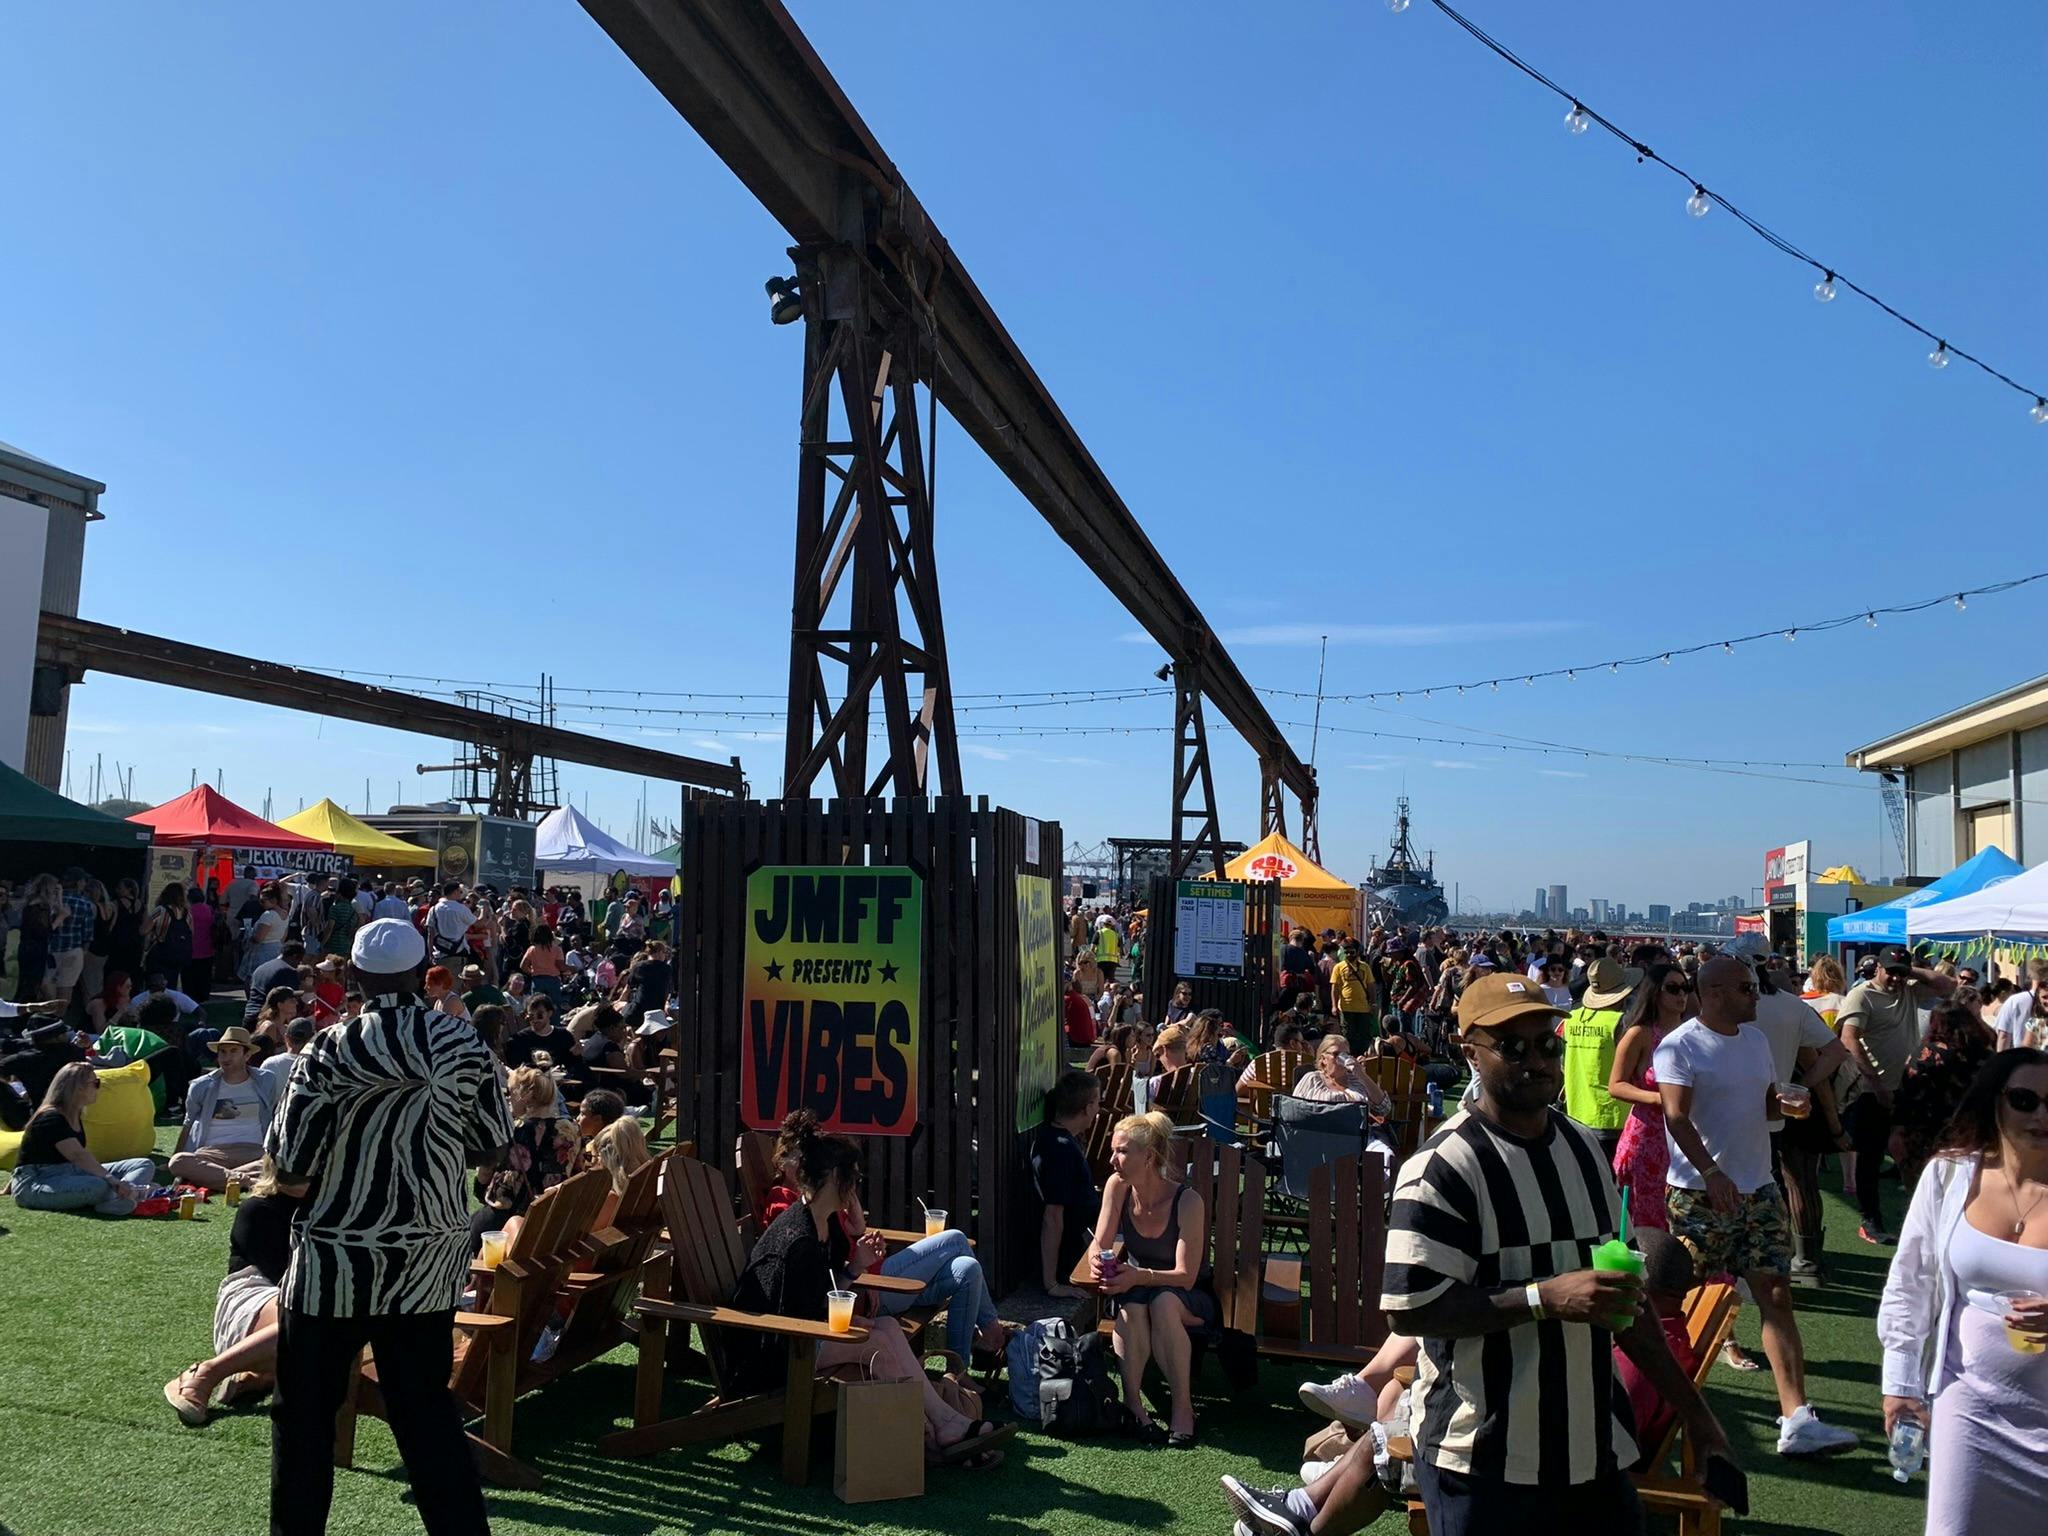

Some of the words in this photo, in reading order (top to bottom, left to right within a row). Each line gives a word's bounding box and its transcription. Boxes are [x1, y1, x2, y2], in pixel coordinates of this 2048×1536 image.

[248, 848, 283, 866] JERK
[286, 851, 342, 873] CENTRE
[1251, 855, 1295, 873] ROLL
[1264, 869, 1291, 879] IES
[1190, 887, 1205, 896] SET
[1207, 888, 1232, 898] TIMES
[1303, 892, 1350, 900] DOUGHNUTS
[754, 875, 912, 944] JMFF
[791, 958, 873, 985] PRESENTS
[750, 999, 911, 1128] VIBES
